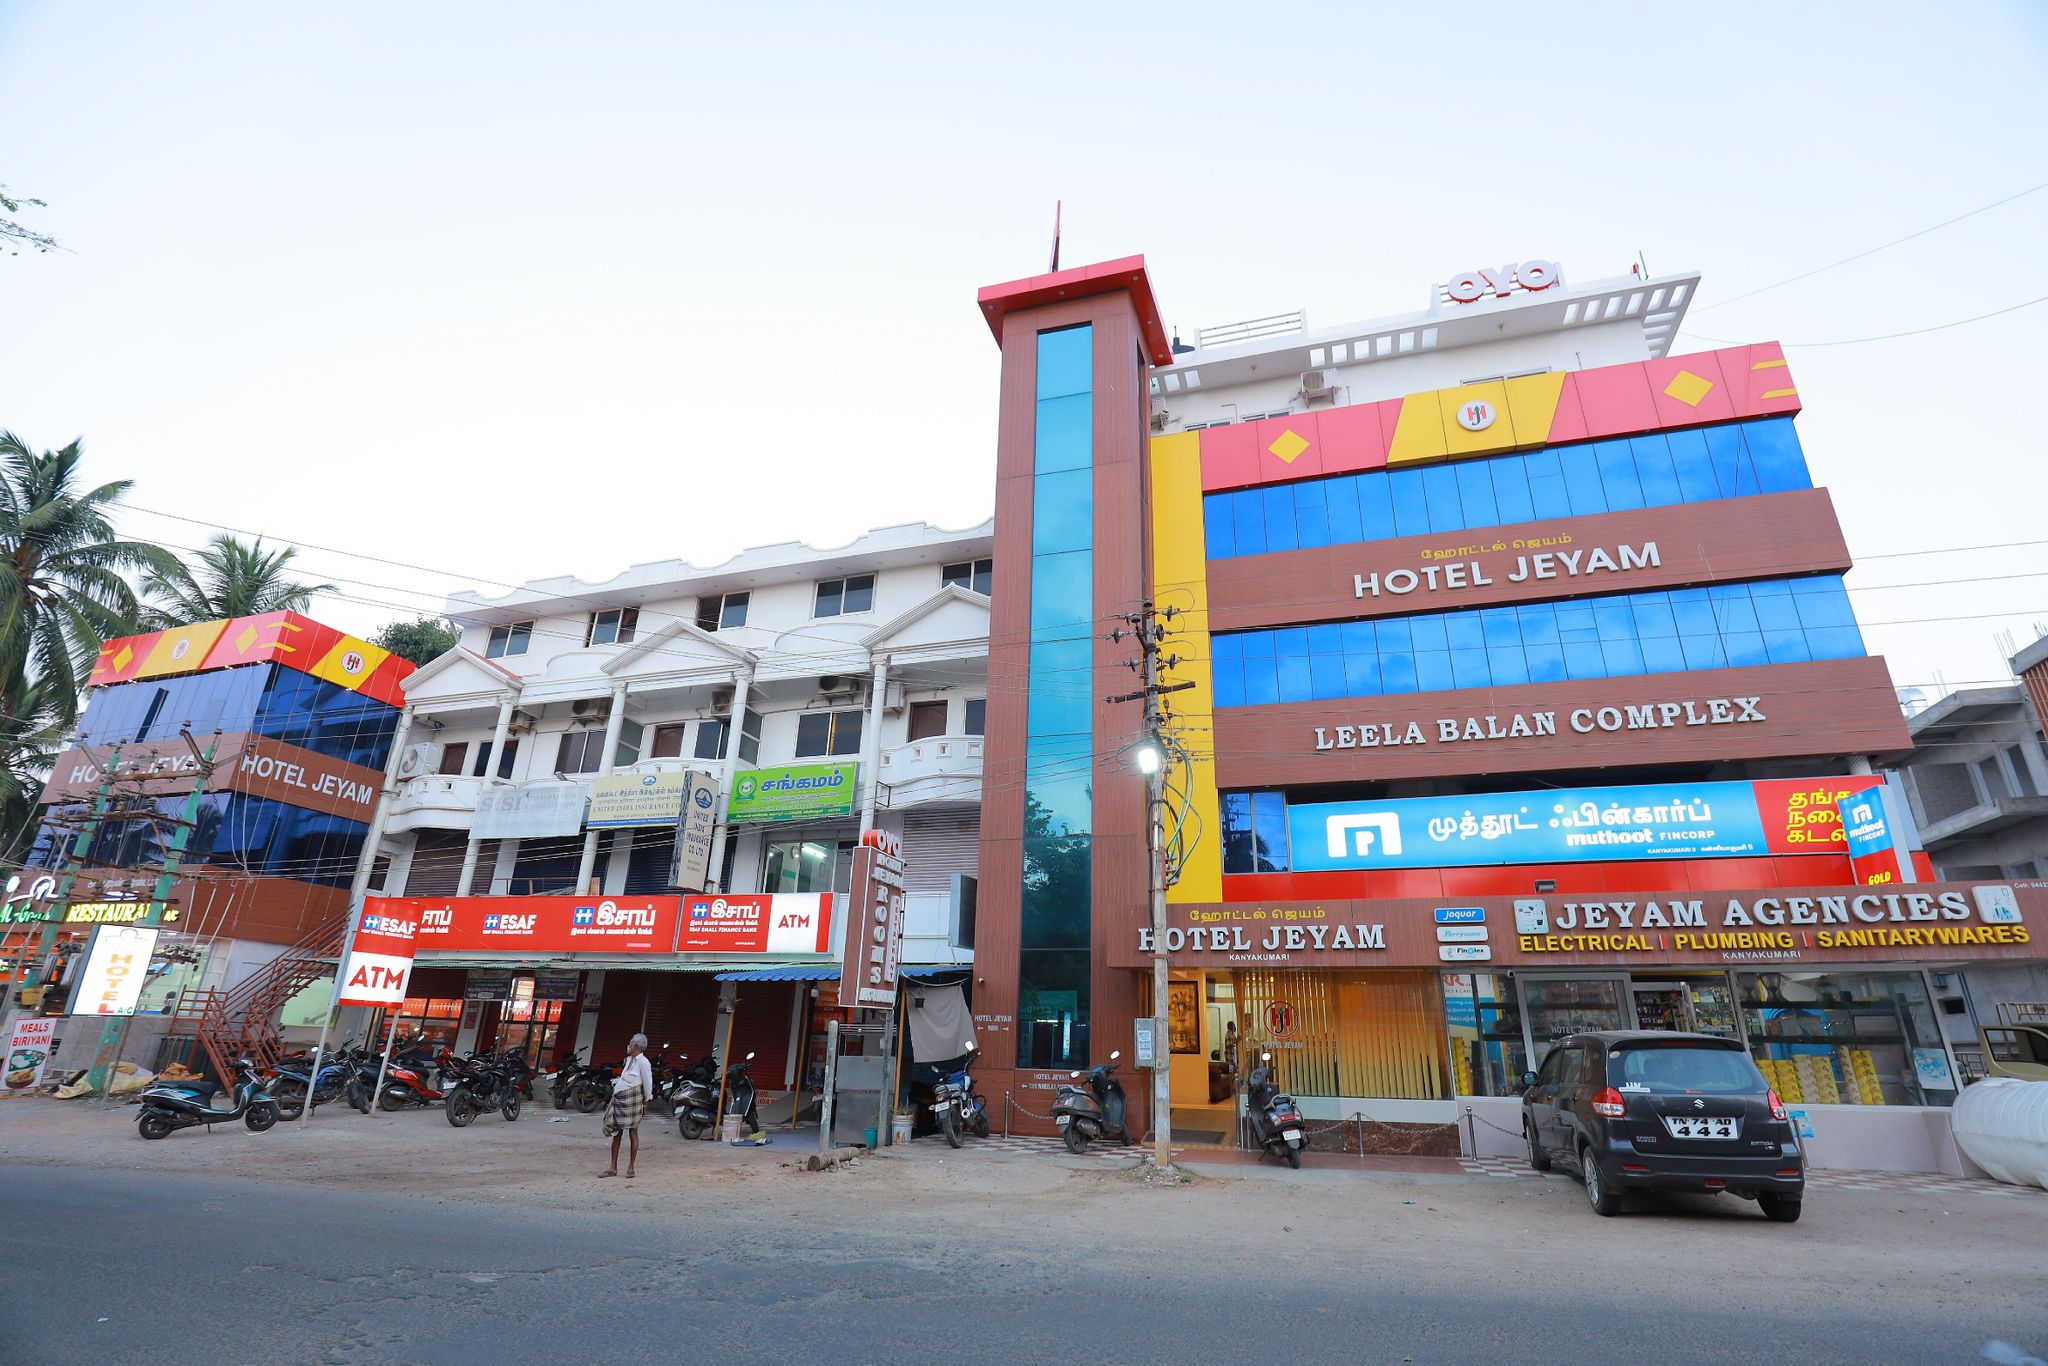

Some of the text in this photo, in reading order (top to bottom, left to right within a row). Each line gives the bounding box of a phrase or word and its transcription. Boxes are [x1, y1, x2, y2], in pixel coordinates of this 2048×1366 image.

[1448, 259, 1556, 303] OYO
[1421, 532, 1573, 561] ஹோட்டல் ஜெயம்
[1354, 541, 1662, 598] HOTEL JEYAM
[1314, 696, 1766, 750] LEELA BALAN COMPLEX
[241, 753, 373, 804] HOTEL JEYAM
[760, 769, 844, 792] சங்கமம்
[1428, 806, 1539, 842] முத்தூட்
[868, 829, 902, 859] OYO
[1567, 828, 1715, 847] muthoot FINCORP
[1859, 829, 1885, 843] FINCORP
[1868, 871, 1891, 885] GOLD
[595, 900, 656, 926] இசாப்
[711, 899, 760, 918] இசாப்
[1190, 906, 1326, 923] ஹோட்டல் ஜெயம்
[1556, 892, 1970, 929] JEYAM AGENCIES
[380, 917, 417, 935] ESAF
[500, 914, 537, 929] ESAF
[778, 914, 810, 929] ATM
[1138, 925, 1386, 951] HOTEL JEYAM
[1519, 925, 2030, 951] ELECTRICAL PLUMBING SANITARYWARES
[1229, 953, 1290, 961] KANYAKUMARI
[1722, 950, 1801, 960] KANYAKUMARI
[348, 965, 405, 990] ATM
[20, 1022, 49, 1033] MEALS
[12, 1034, 50, 1047] BIRIYANI
